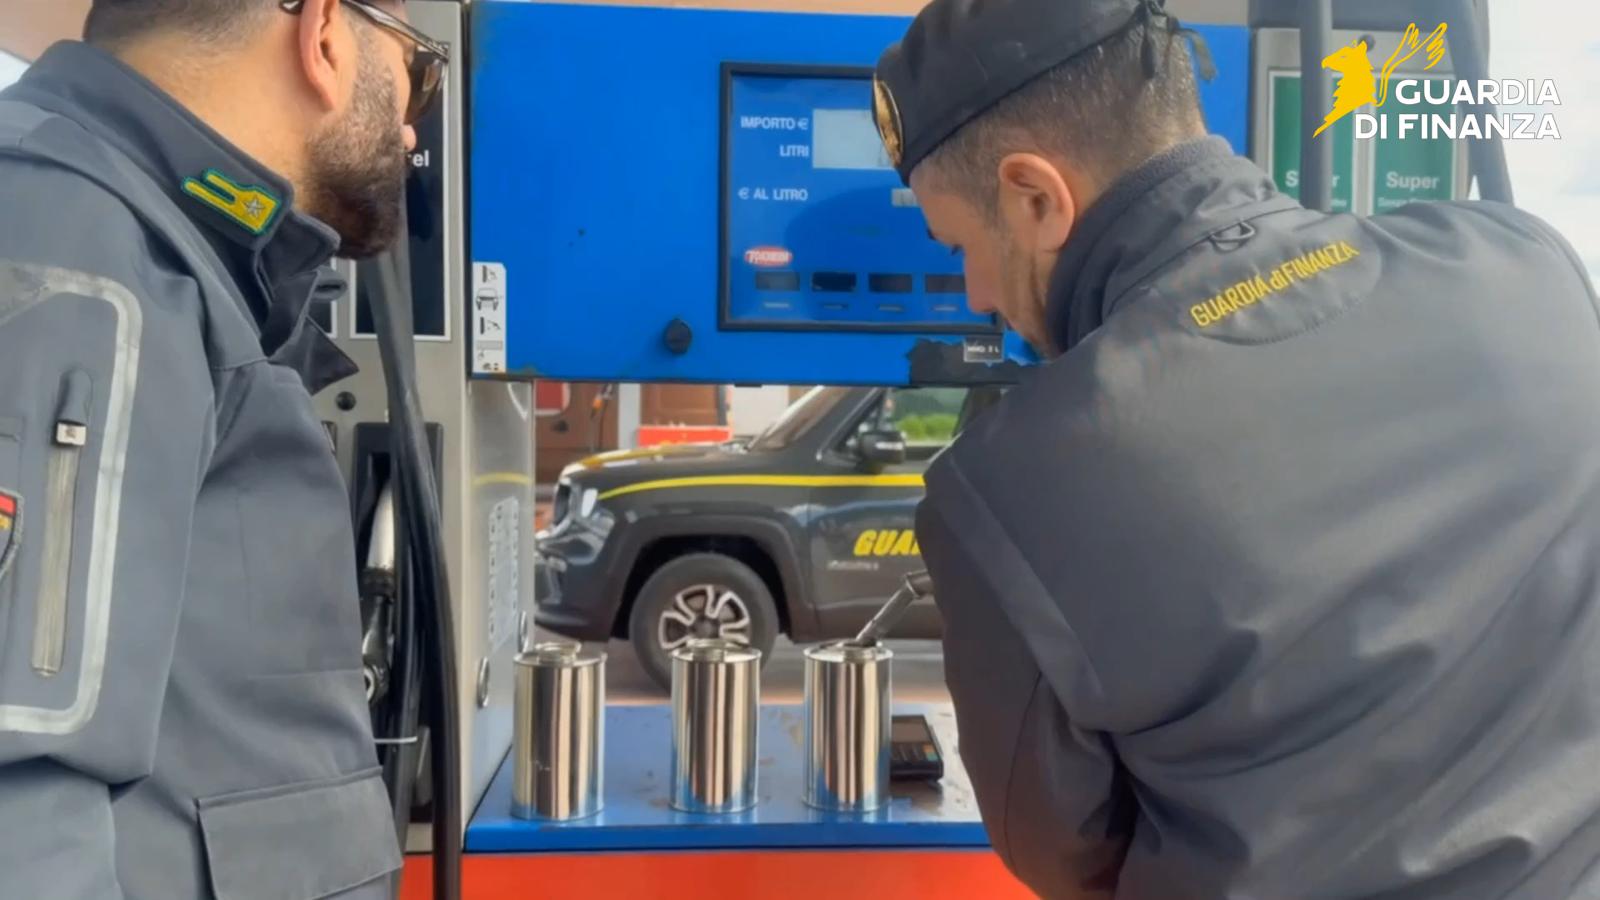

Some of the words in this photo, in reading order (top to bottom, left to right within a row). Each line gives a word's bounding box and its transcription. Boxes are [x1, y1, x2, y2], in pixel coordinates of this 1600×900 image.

[740, 115, 796, 130] IMPORTO
[797, 117, 809, 130] €
[407, 149, 429, 167] el
[779, 144, 809, 158] LITRI
[1386, 170, 1441, 192] Super
[738, 186, 750, 200] €
[753, 186, 769, 200] AL
[773, 187, 808, 201] LITRO
[1190, 273, 1272, 327] GUARDIA
[1281, 240, 1361, 283] FINANZA
